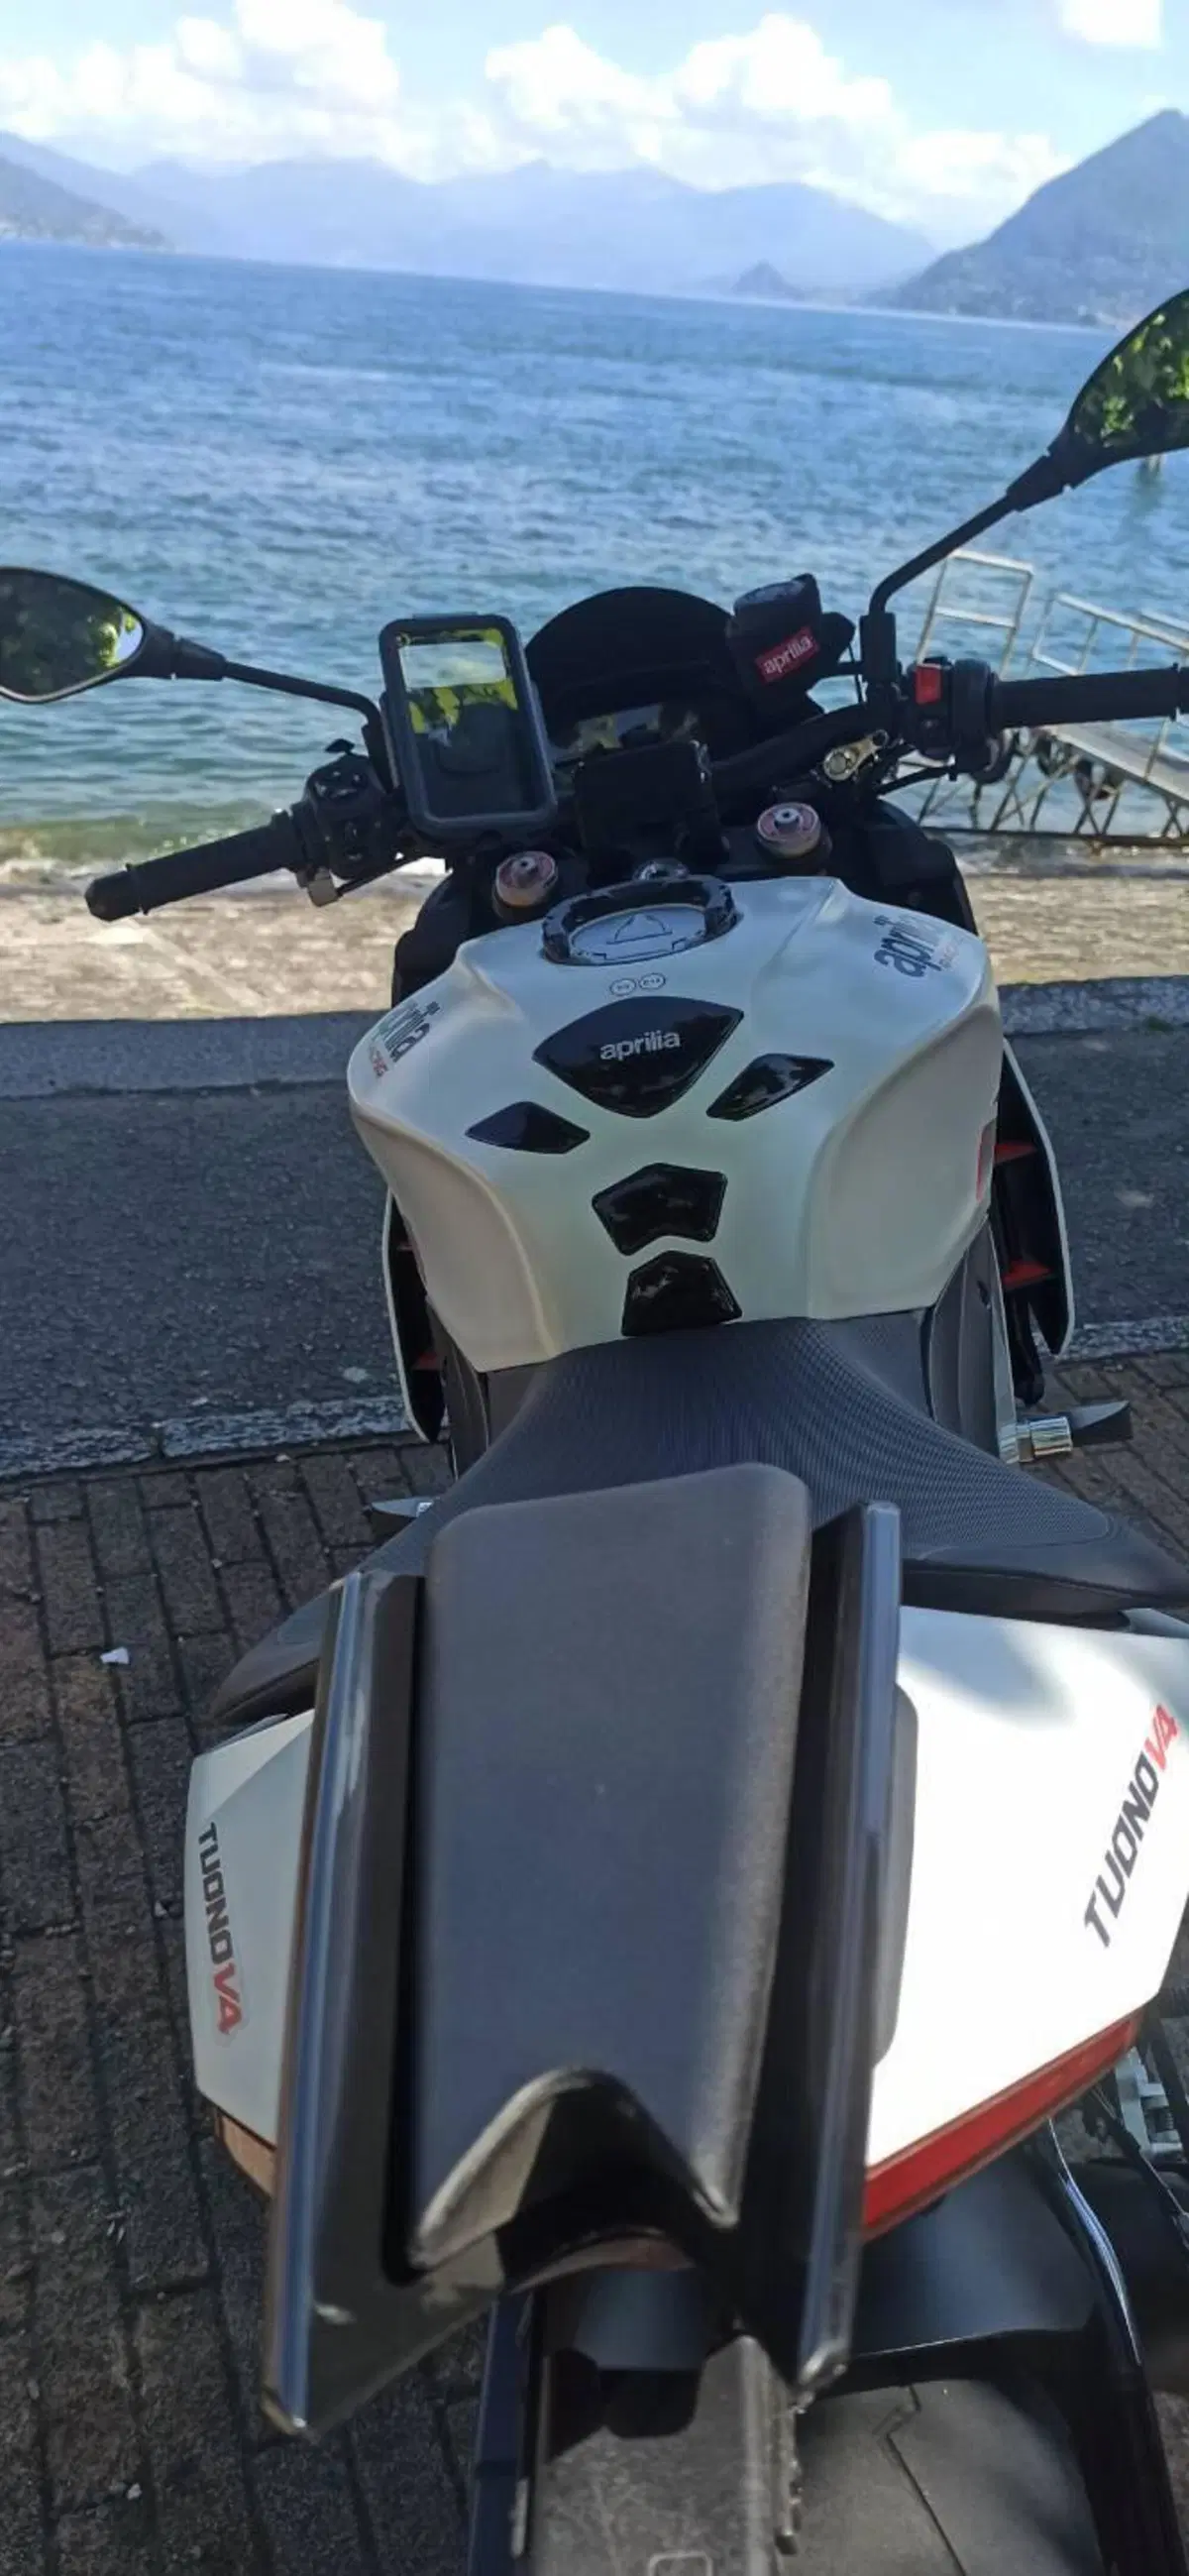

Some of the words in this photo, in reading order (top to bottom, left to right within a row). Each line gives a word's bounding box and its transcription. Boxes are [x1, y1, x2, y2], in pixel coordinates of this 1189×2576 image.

[762, 634, 813, 674] aprilia
[872, 915, 942, 977] apri
[599, 1029, 681, 1062] aprilia
